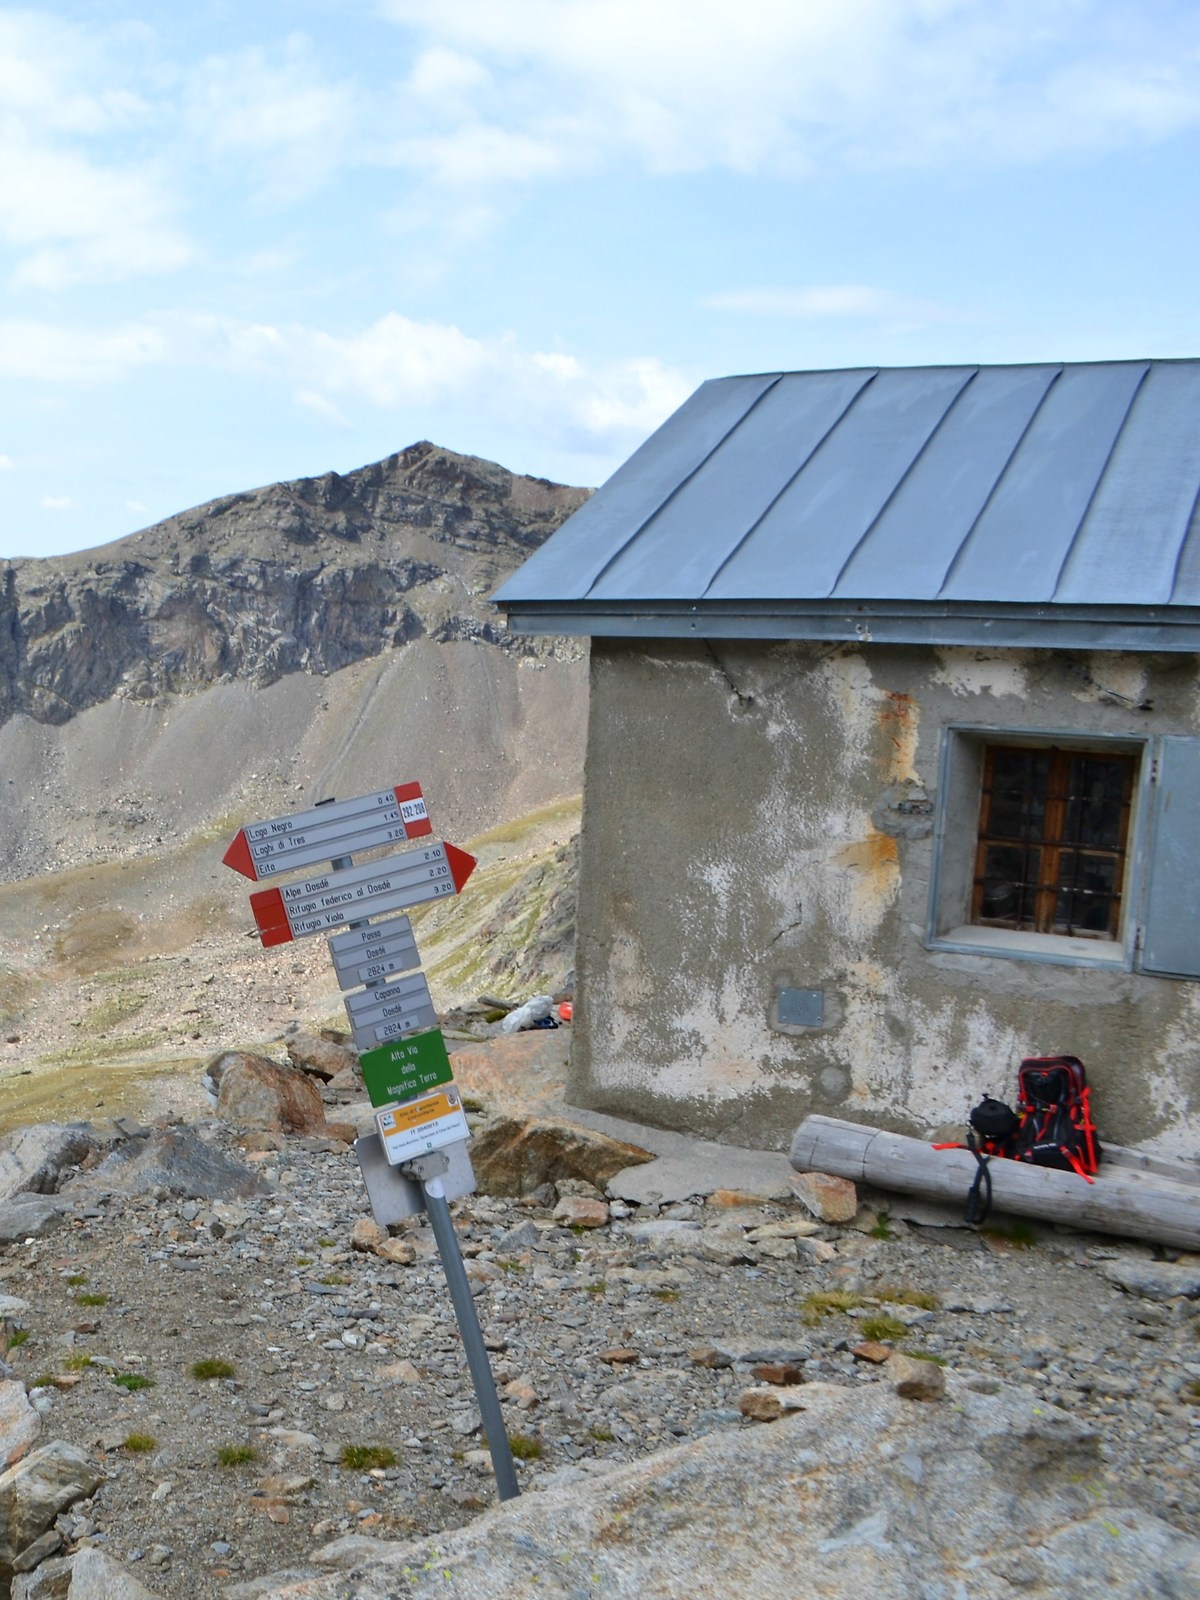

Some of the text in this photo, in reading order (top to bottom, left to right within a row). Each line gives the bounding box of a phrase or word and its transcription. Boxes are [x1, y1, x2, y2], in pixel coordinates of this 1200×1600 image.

[377, 794, 394, 804] 0.40
[384, 812, 399, 820] 1.45
[271, 821, 293, 833] Negro
[387, 828, 404, 838] 3.20
[254, 835, 306, 856] Laghi di Tres
[424, 849, 441, 859] 2.10
[259, 863, 276, 874] Eita
[429, 866, 447, 877] 2.20
[285, 888, 302, 898] Alpe
[434, 883, 452, 894] 3.20
[289, 903, 317, 916] Rifugio
[321, 892, 353, 907] Federico
[357, 888, 364, 896] al
[294, 912, 344, 932] Rifugio Viola
[361, 930, 382, 941] Passo
[367, 962, 395, 977] 2824 m
[374, 986, 401, 1001] Capanna
[383, 1020, 411, 1036] 2824 m
[390, 1045, 418, 1061] Alta Via
[401, 1062, 416, 1075] della
[387, 1071, 438, 1096] Magnifica Terra
